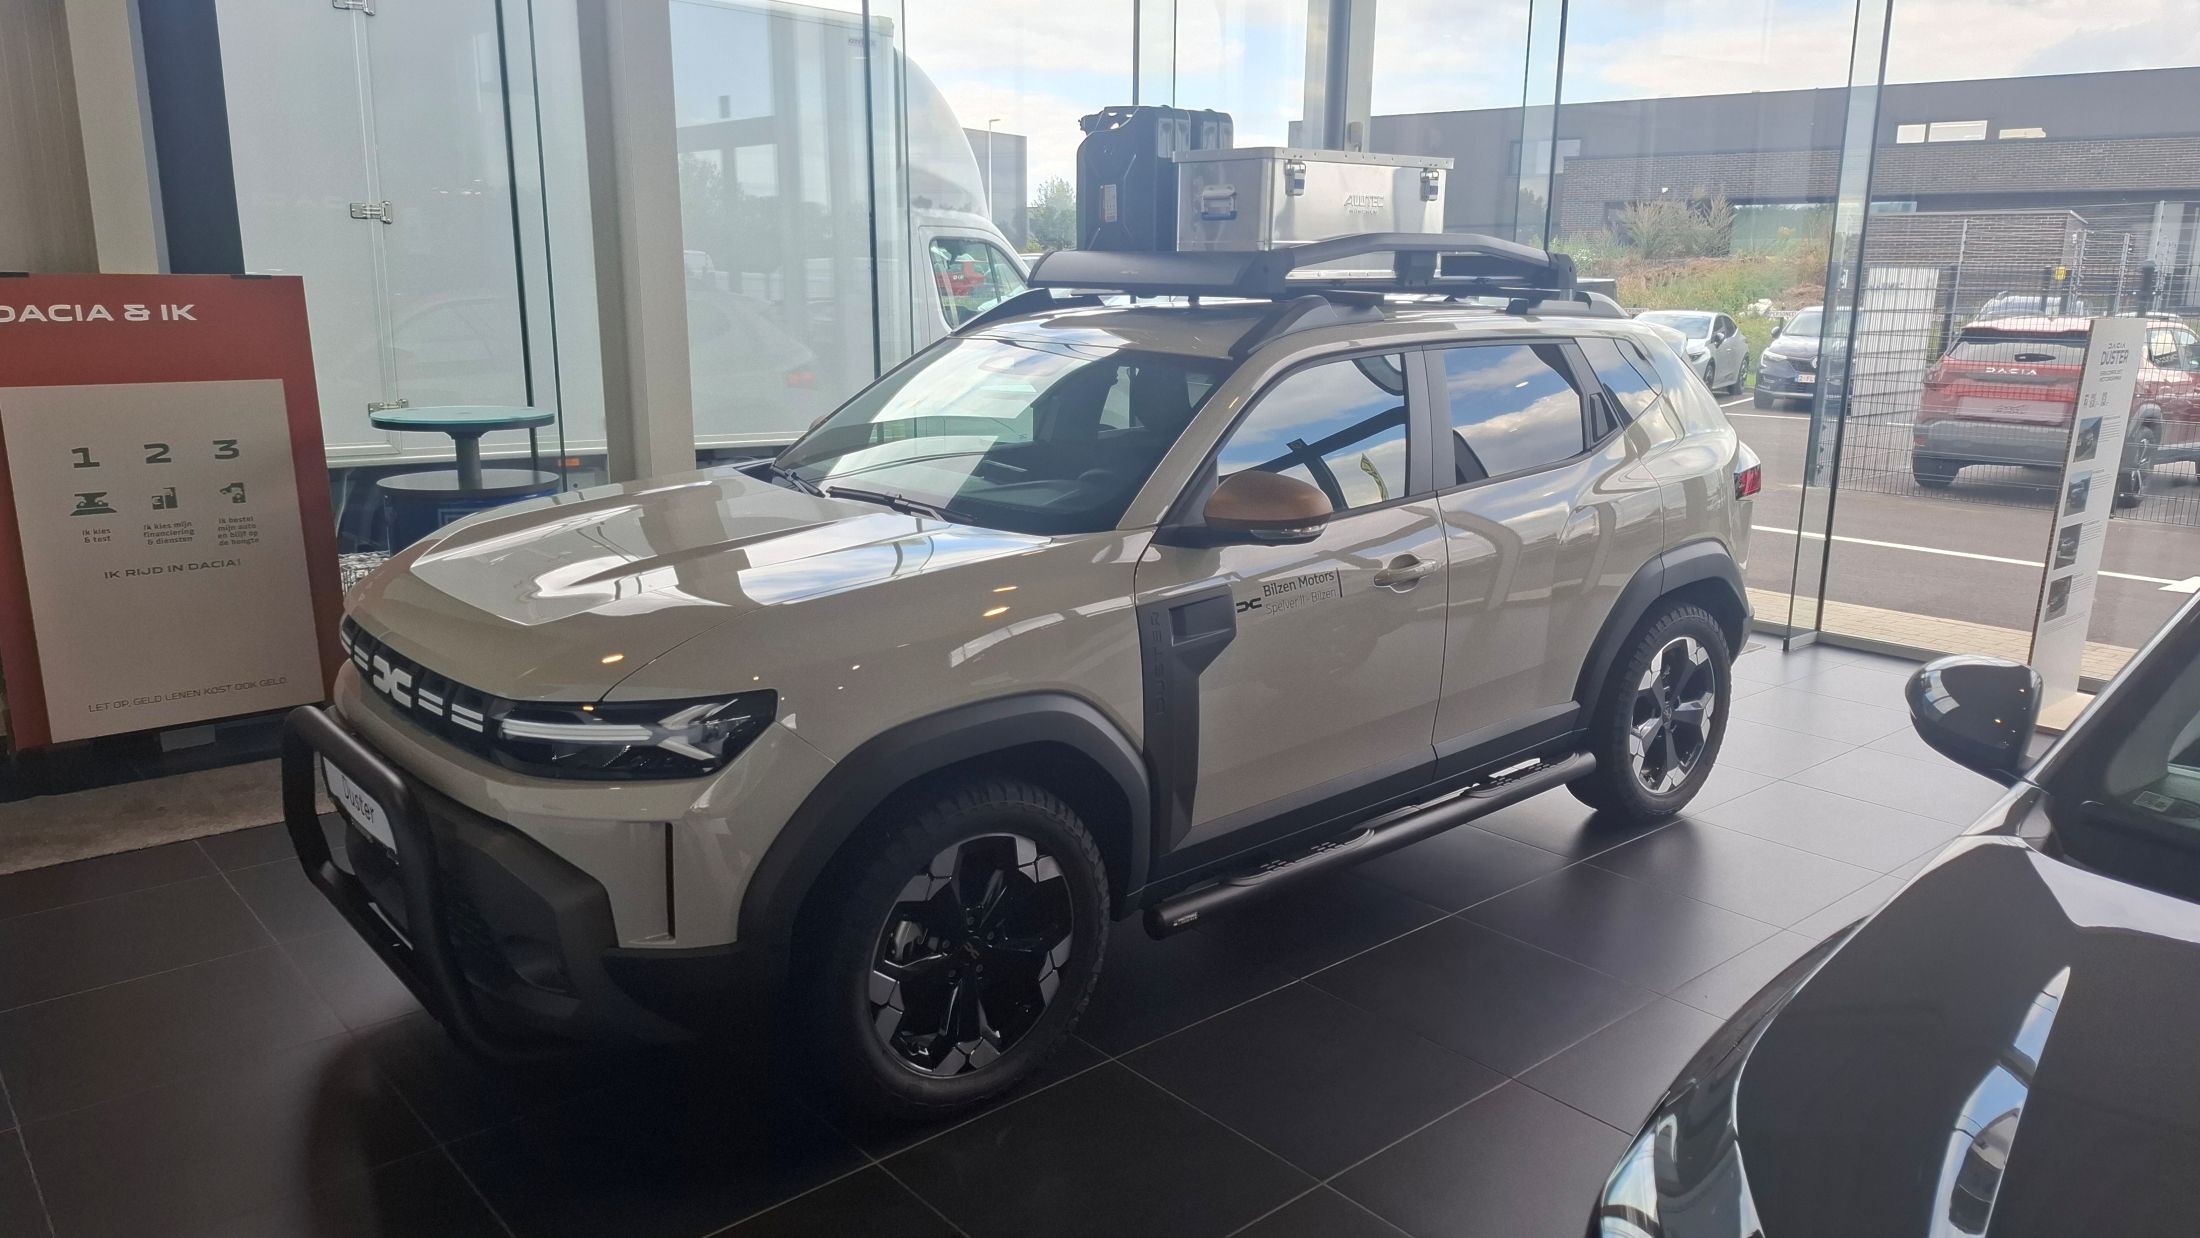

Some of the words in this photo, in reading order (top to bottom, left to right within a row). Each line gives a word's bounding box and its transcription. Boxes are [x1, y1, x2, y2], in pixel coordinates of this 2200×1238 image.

[0, 304, 114, 322] DACIA
[124, 304, 150, 321] &
[160, 304, 198, 321] IK
[2100, 350, 2129, 365] DUSTER
[1985, 367, 2037, 375] DACIA
[72, 448, 100, 468] 1
[144, 443, 171, 463] 2
[213, 440, 239, 459] 3
[104, 570, 120, 579] IK
[126, 567, 163, 577] RIJD
[168, 564, 183, 573] IN
[188, 559, 241, 570] DACIA!
[1263, 581, 1296, 597] Bilzen
[1298, 571, 1334, 588] Motors
[1311, 589, 1336, 602] Bilzen
[88, 702, 113, 712] LET
[134, 695, 161, 706] GELD
[166, 690, 200, 701] LENEN
[204, 684, 232, 695] KOST
[342, 775, 374, 824] Duster
